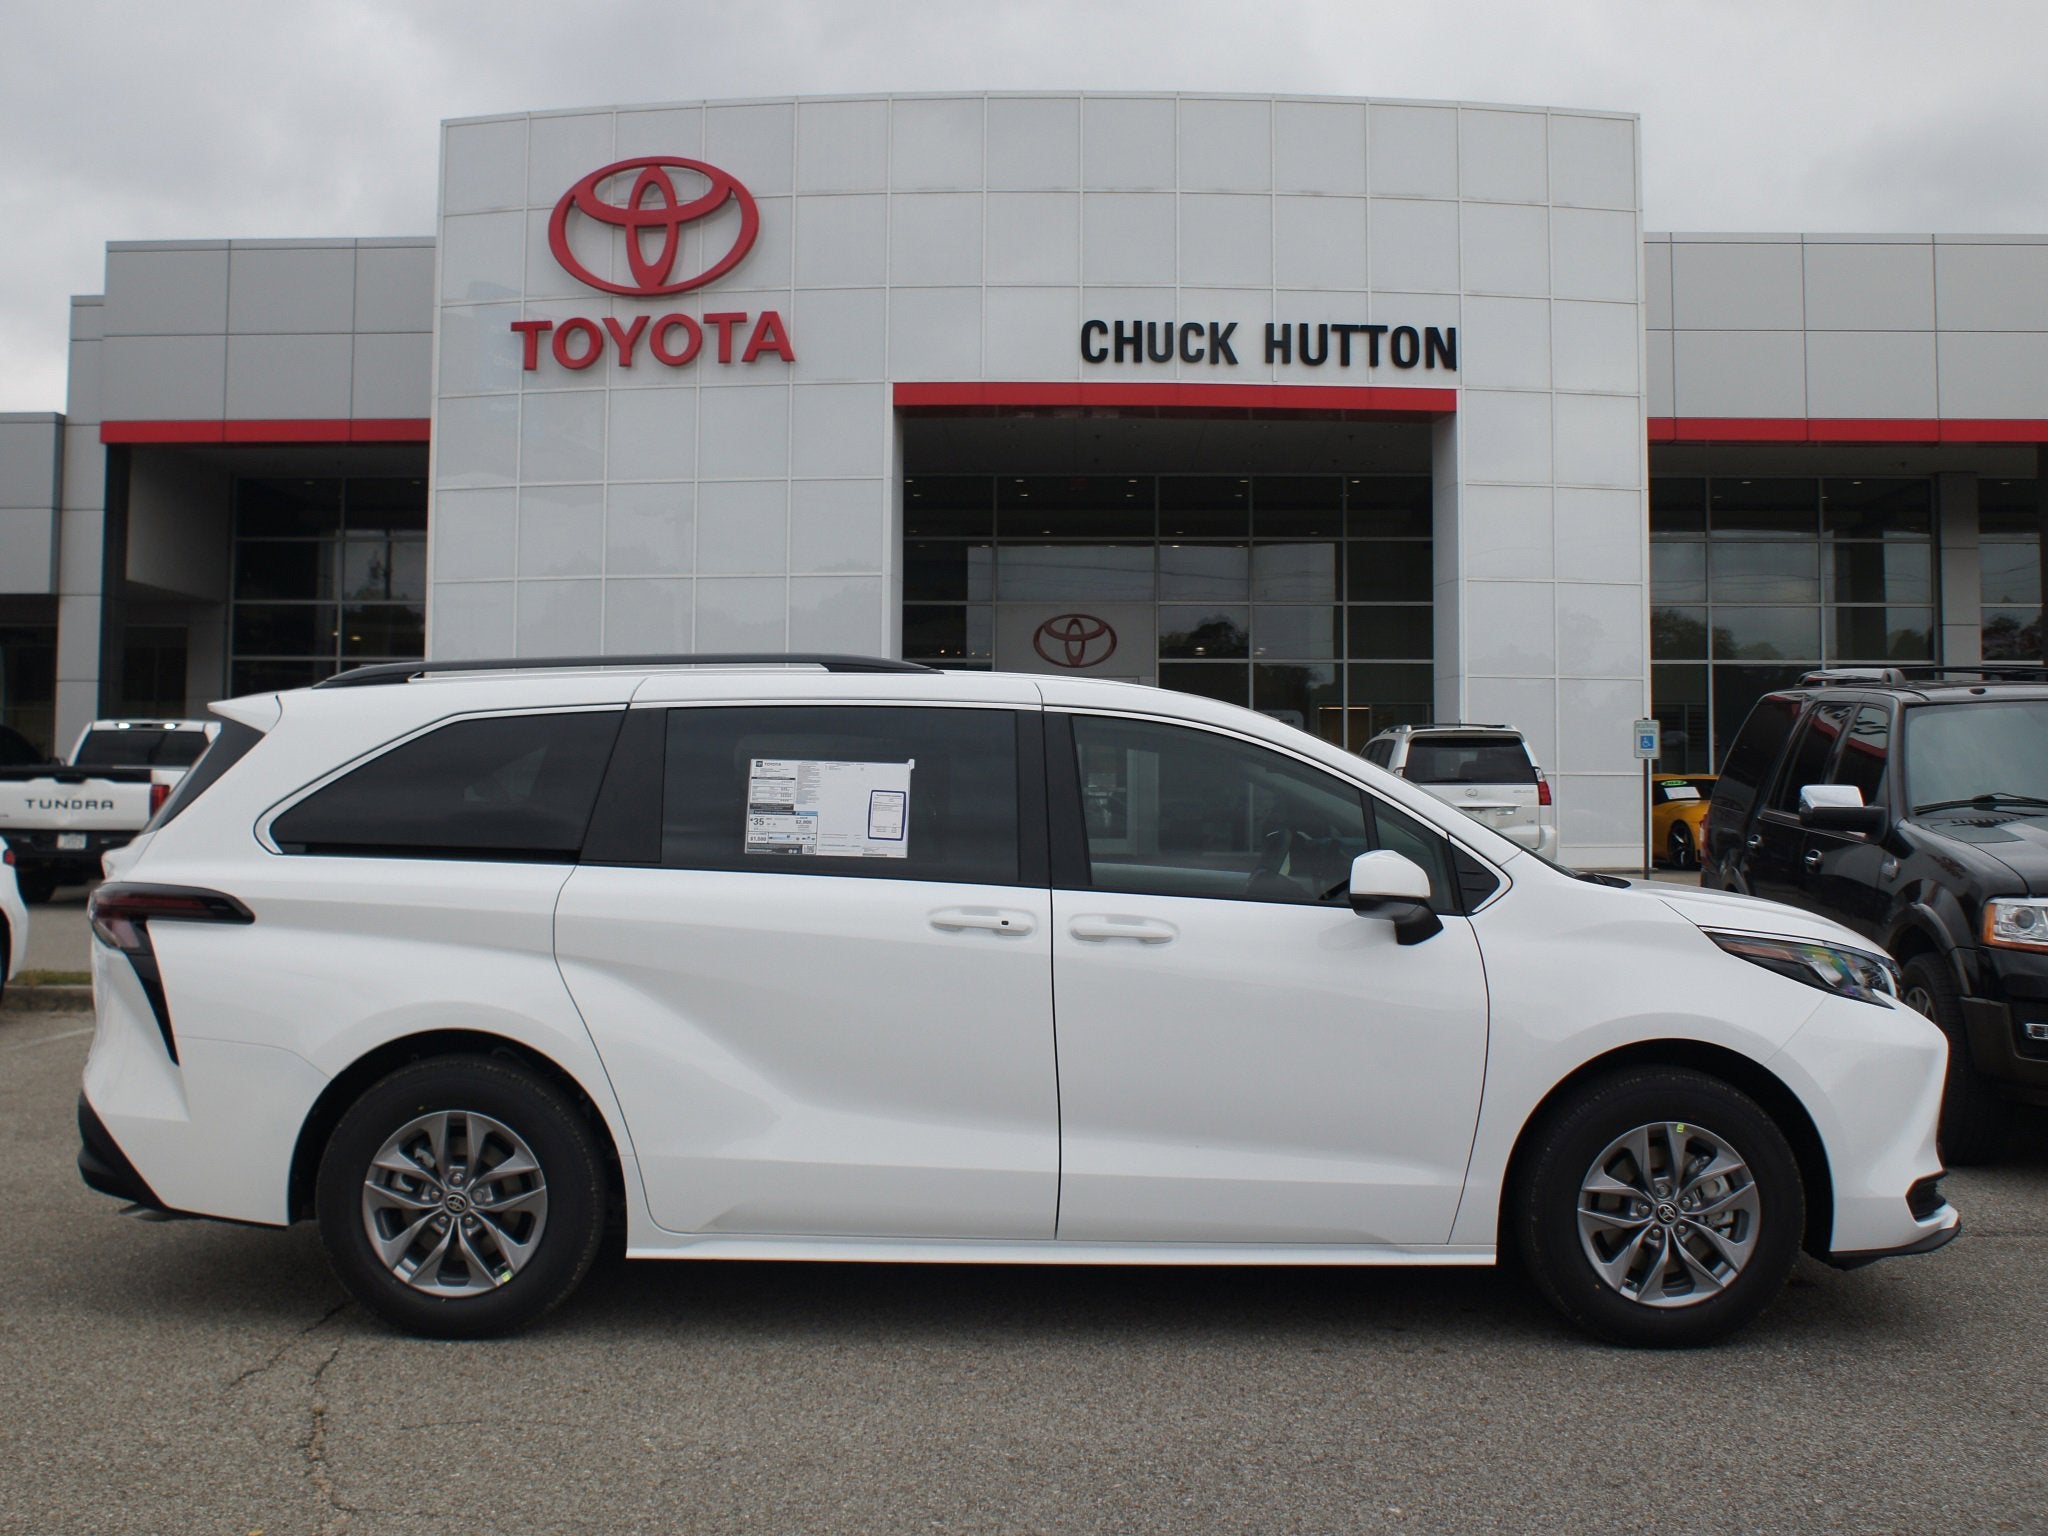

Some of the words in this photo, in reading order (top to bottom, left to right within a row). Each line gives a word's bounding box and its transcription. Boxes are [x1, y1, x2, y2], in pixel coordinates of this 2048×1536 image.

[510, 311, 796, 371] TOYOTA
[1081, 319, 1239, 366] CHUCK
[1264, 322, 1458, 371] HUTTON
[25, 799, 114, 810] TUNDRA
[753, 817, 765, 826] 35
